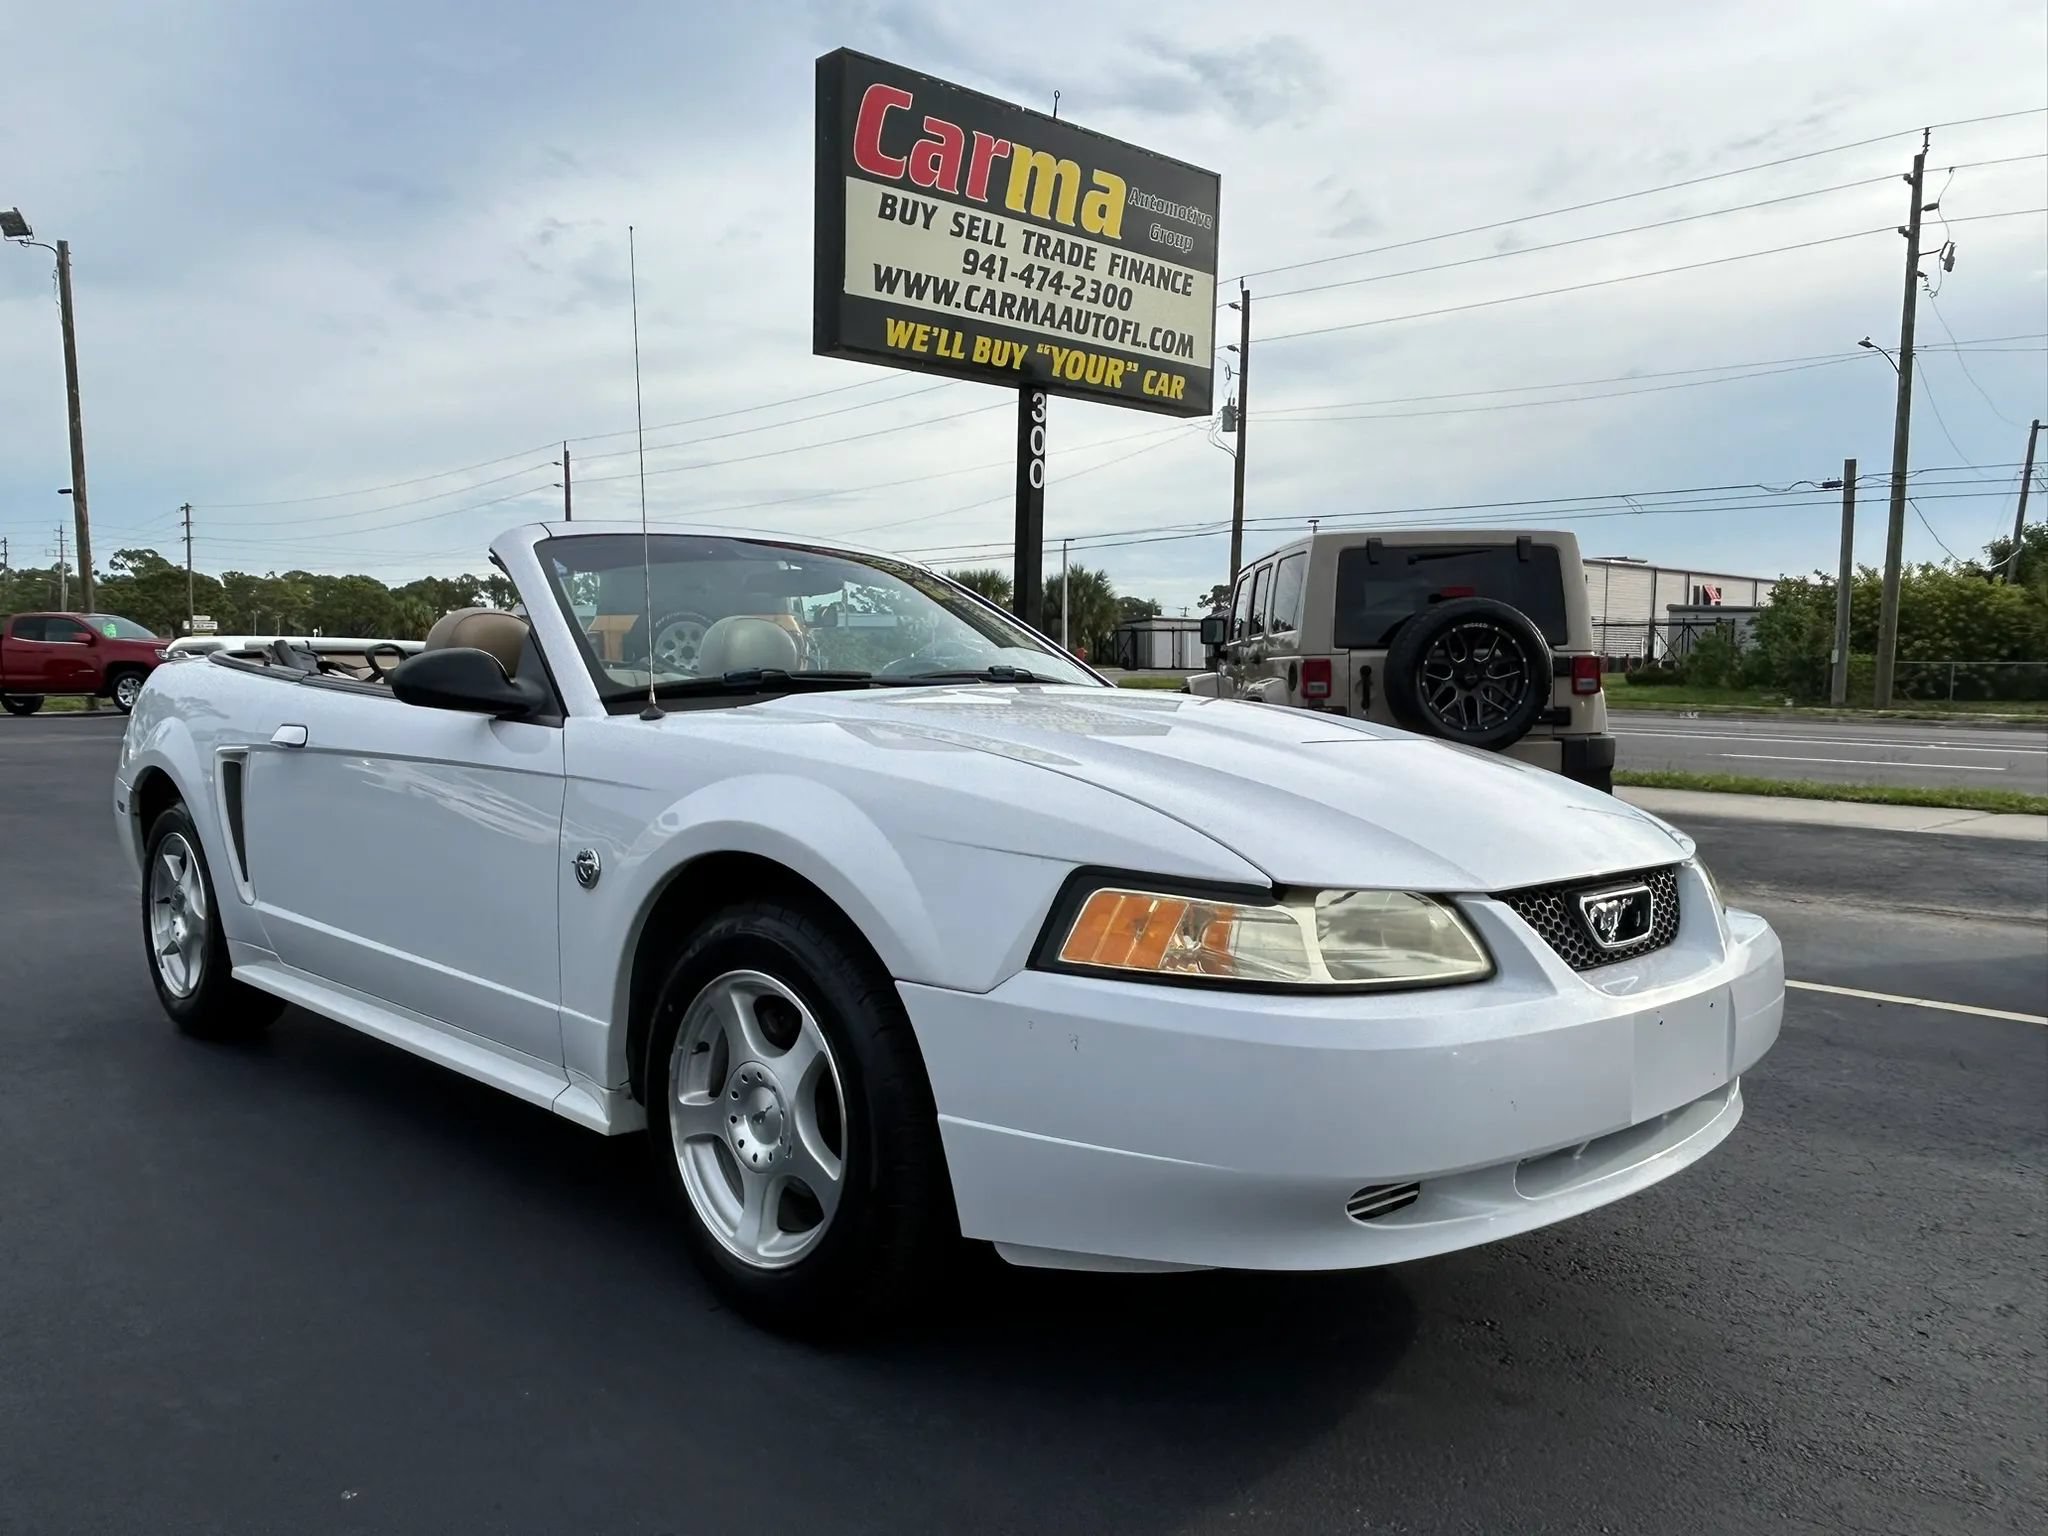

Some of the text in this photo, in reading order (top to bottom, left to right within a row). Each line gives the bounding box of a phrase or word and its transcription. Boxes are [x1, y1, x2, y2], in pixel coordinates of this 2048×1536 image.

[853, 83, 1127, 240] Carma
[878, 192, 1194, 297] BUY SELL TRADE FINANCE
[1128, 187, 1213, 230] Automotive
[1149, 222, 1194, 254] Group
[873, 263, 1195, 359] WWW.CARMAAUTOFL.COM
[962, 248, 1133, 312] 941-474-2300
[885, 318, 1185, 400] WE'LL BUY "YOUR" CAR
[1029, 392, 1046, 489] 300
